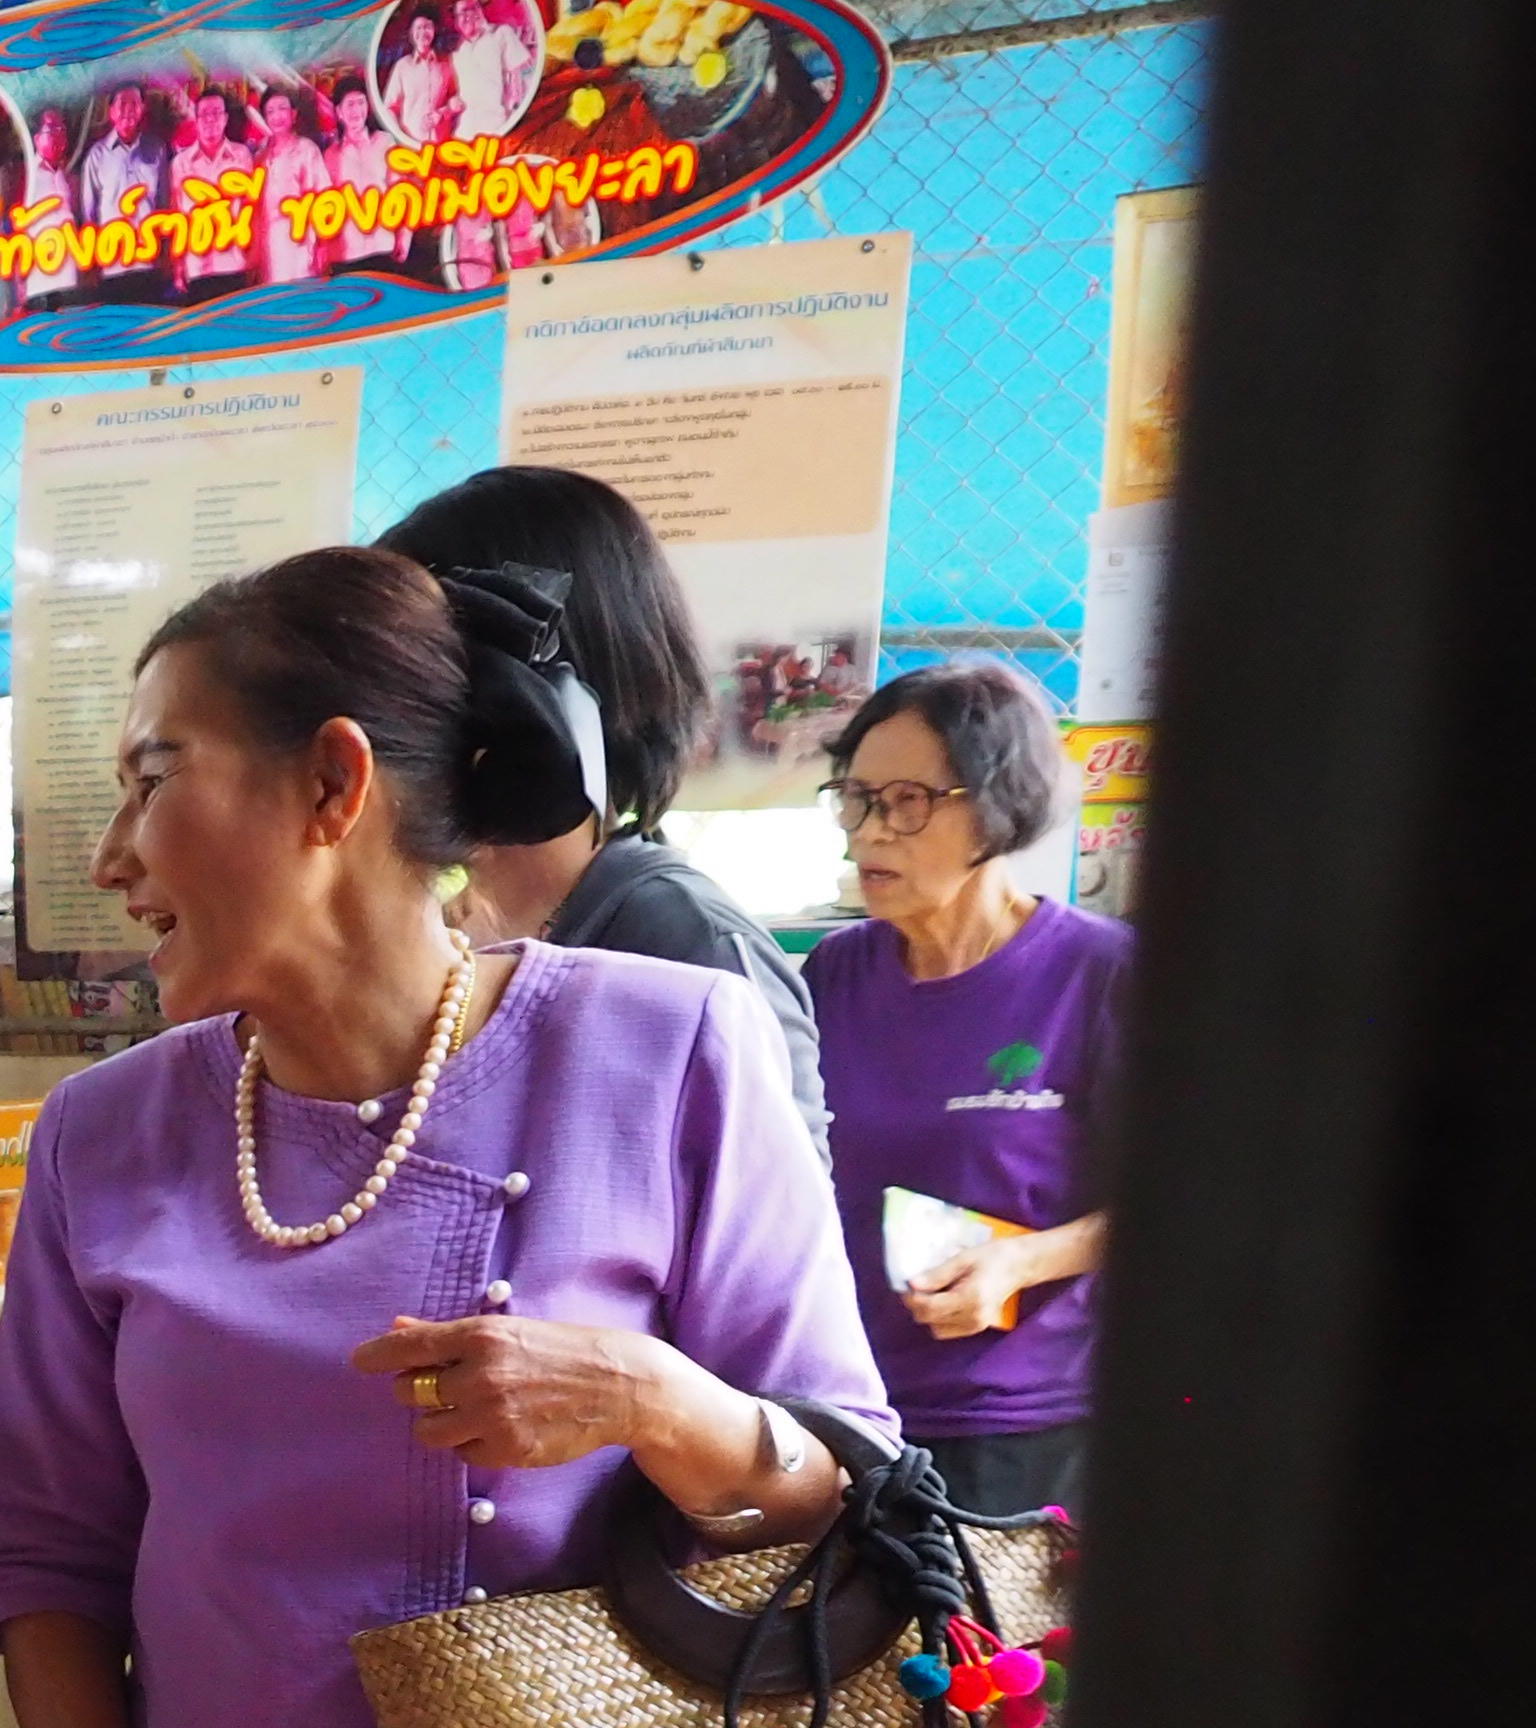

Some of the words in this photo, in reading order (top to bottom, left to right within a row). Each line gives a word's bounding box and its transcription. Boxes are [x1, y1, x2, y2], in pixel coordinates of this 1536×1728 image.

[280, 134, 698, 242] ของดีเมืองยะลา
